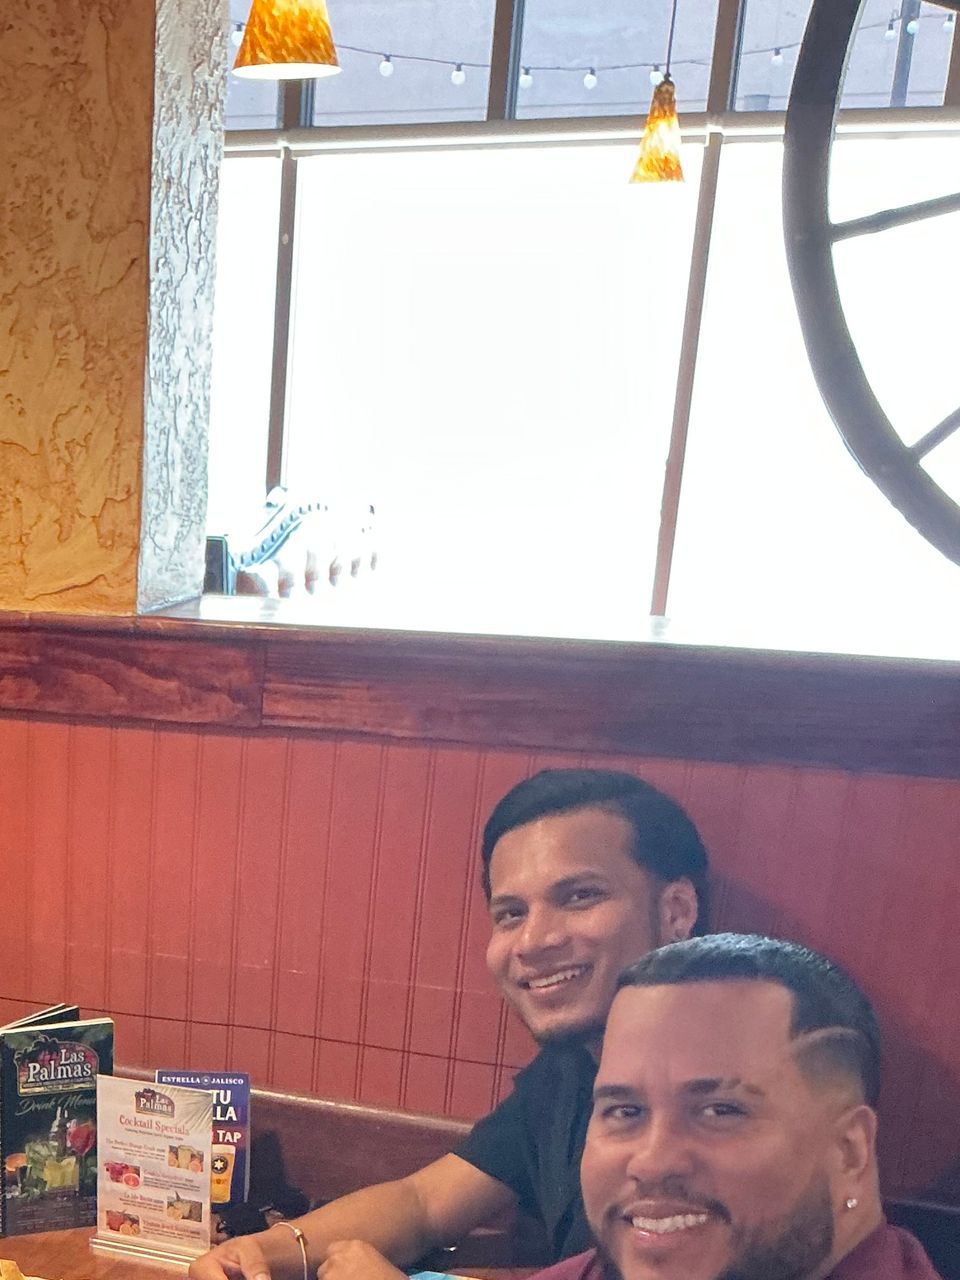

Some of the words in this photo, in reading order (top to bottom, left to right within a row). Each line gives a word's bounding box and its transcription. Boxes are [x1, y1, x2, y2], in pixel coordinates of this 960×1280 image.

[60, 1049, 85, 1065] Las
[27, 1060, 92, 1083] Palmas
[161, 1076, 201, 1084] ESTRELLA
[212, 1089, 231, 1105] TU
[140, 1098, 173, 1113] Palmas
[119, 1115, 153, 1130] Cocktail
[155, 1120, 190, 1137] Specials
[217, 1130, 242, 1143] TAP
